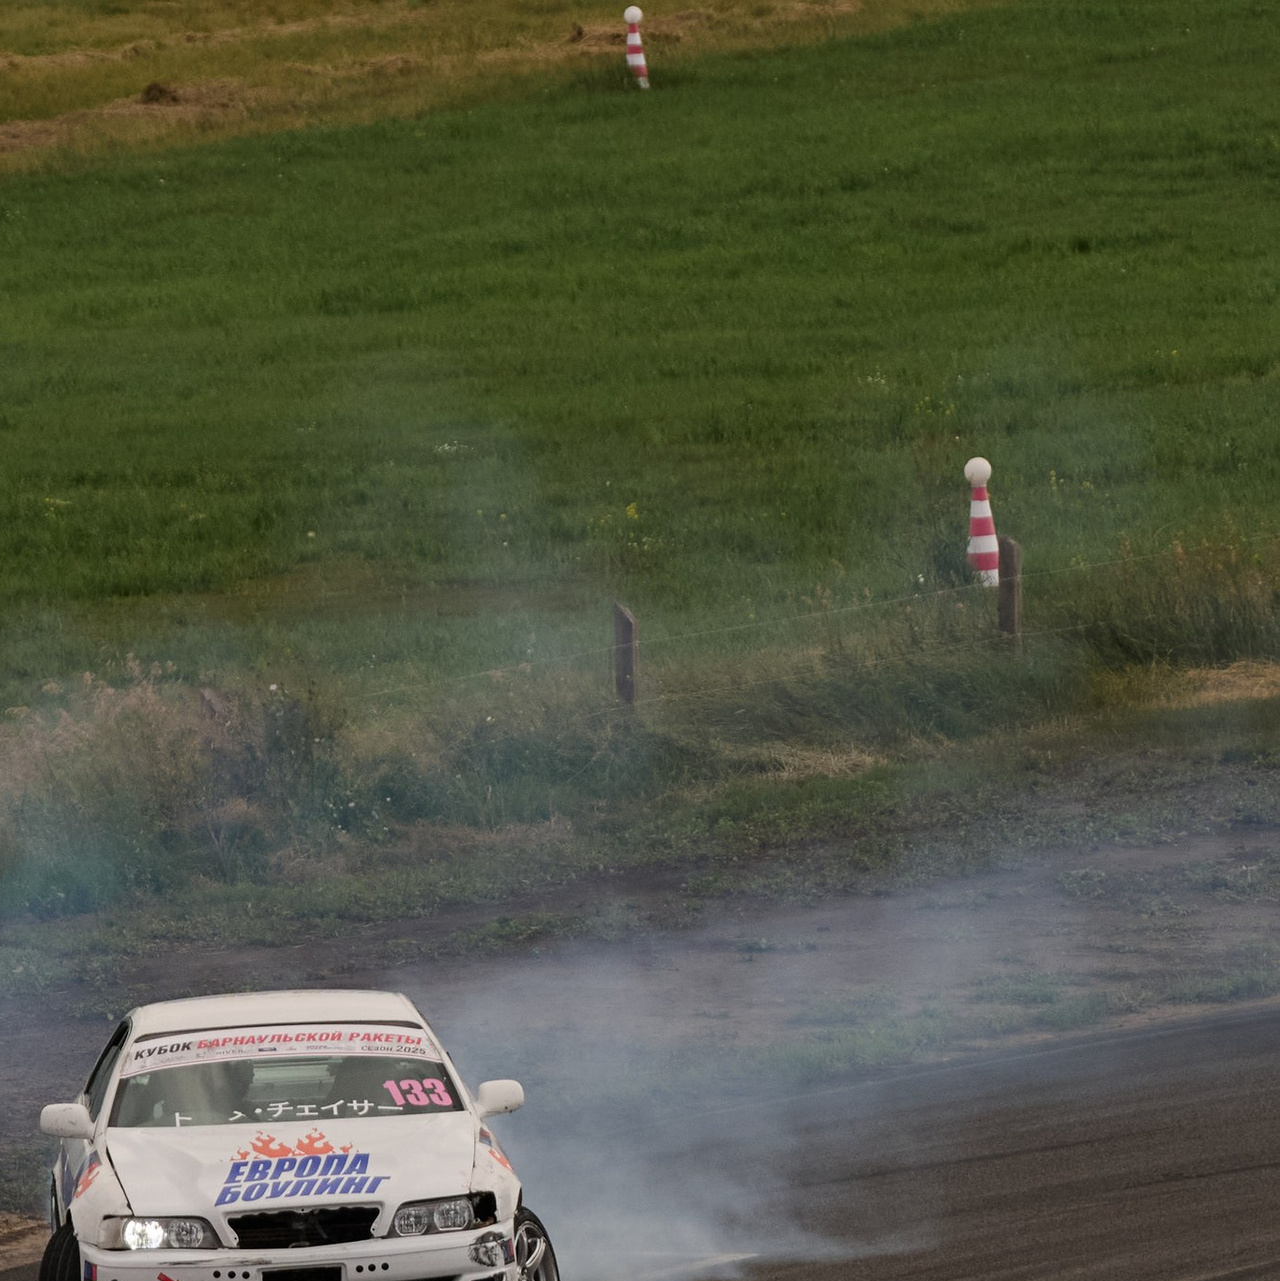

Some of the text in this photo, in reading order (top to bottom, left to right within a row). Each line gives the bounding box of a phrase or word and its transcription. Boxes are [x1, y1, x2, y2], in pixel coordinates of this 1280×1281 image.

[134, 1041, 194, 1061] КУБОК
[197, 1031, 343, 1050] БАРНАУЛЬСКОЙ
[348, 1032, 423, 1046] РАКЕТЫ
[396, 1045, 427, 1055] 2025
[382, 1078, 453, 1107] 133
[224, 1153, 370, 1185] ЕВРОПА
[214, 1176, 391, 1207] БОУЛИНГ
